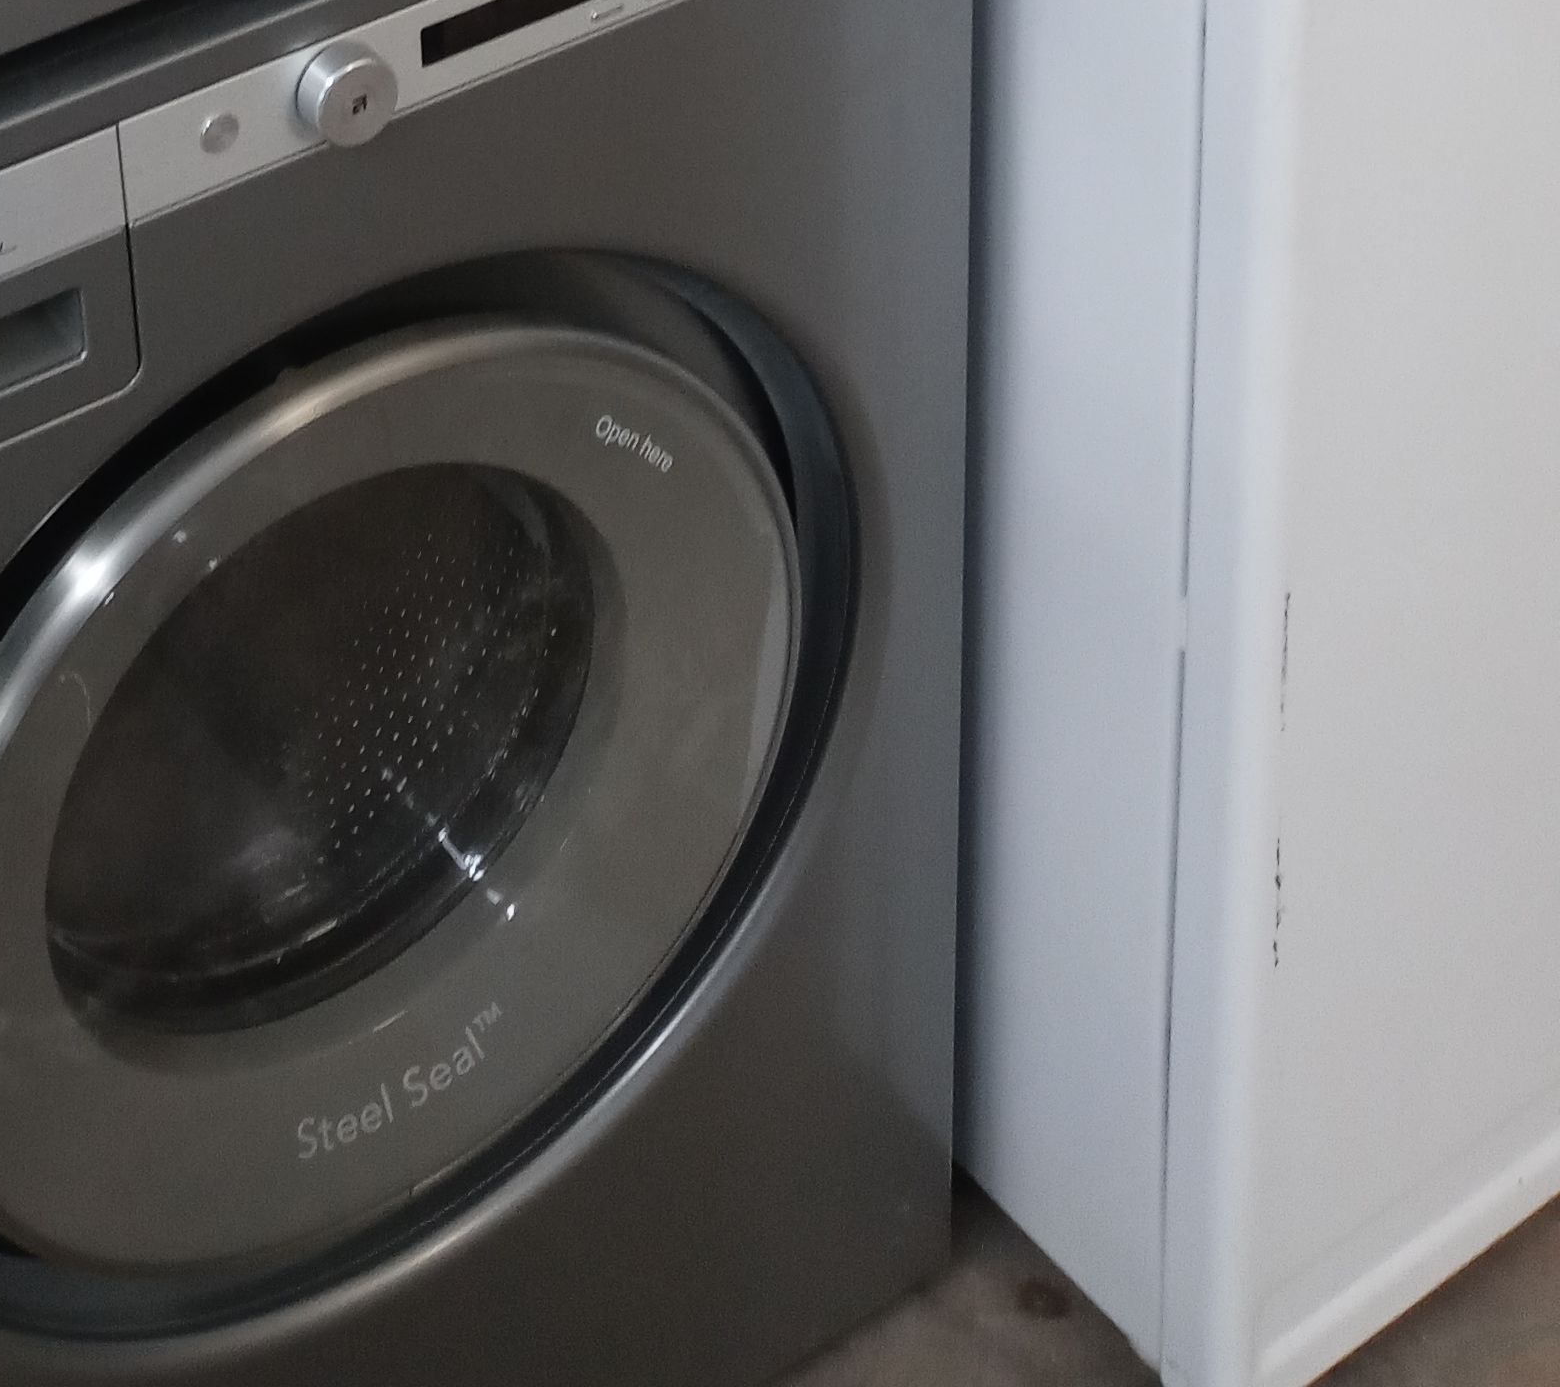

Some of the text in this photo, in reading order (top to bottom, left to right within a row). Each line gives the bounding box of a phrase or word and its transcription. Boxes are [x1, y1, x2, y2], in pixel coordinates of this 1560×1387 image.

[595, 414, 673, 473] Open here
[297, 1082, 395, 1160] Steel
